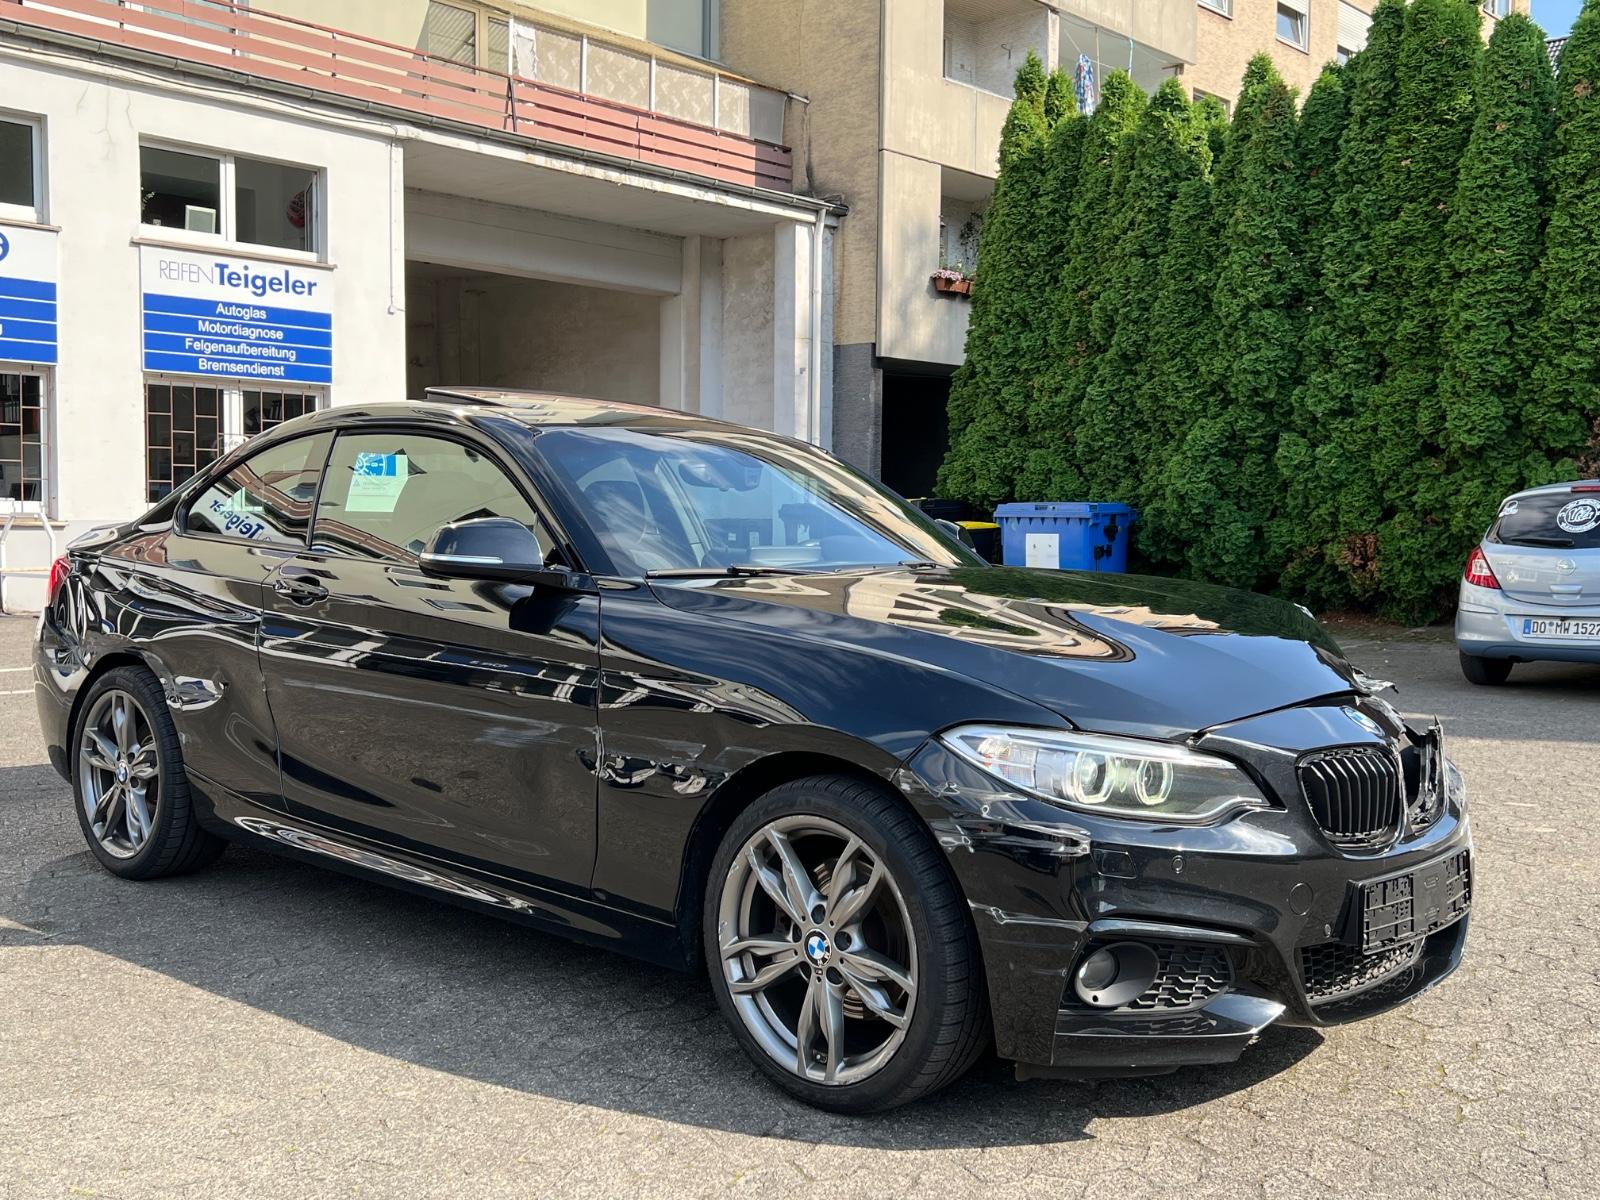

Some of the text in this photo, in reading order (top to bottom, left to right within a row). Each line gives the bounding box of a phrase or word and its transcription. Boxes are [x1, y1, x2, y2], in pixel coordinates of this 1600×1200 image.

[216, 302, 267, 320] Autoglas
[198, 320, 284, 340] Motordiagnose
[185, 337, 296, 361] Felgenaufbereitung
[198, 358, 285, 377] Bremsendienst
[1532, 621, 1547, 634] DO
[1555, 622, 1571, 634] MW
